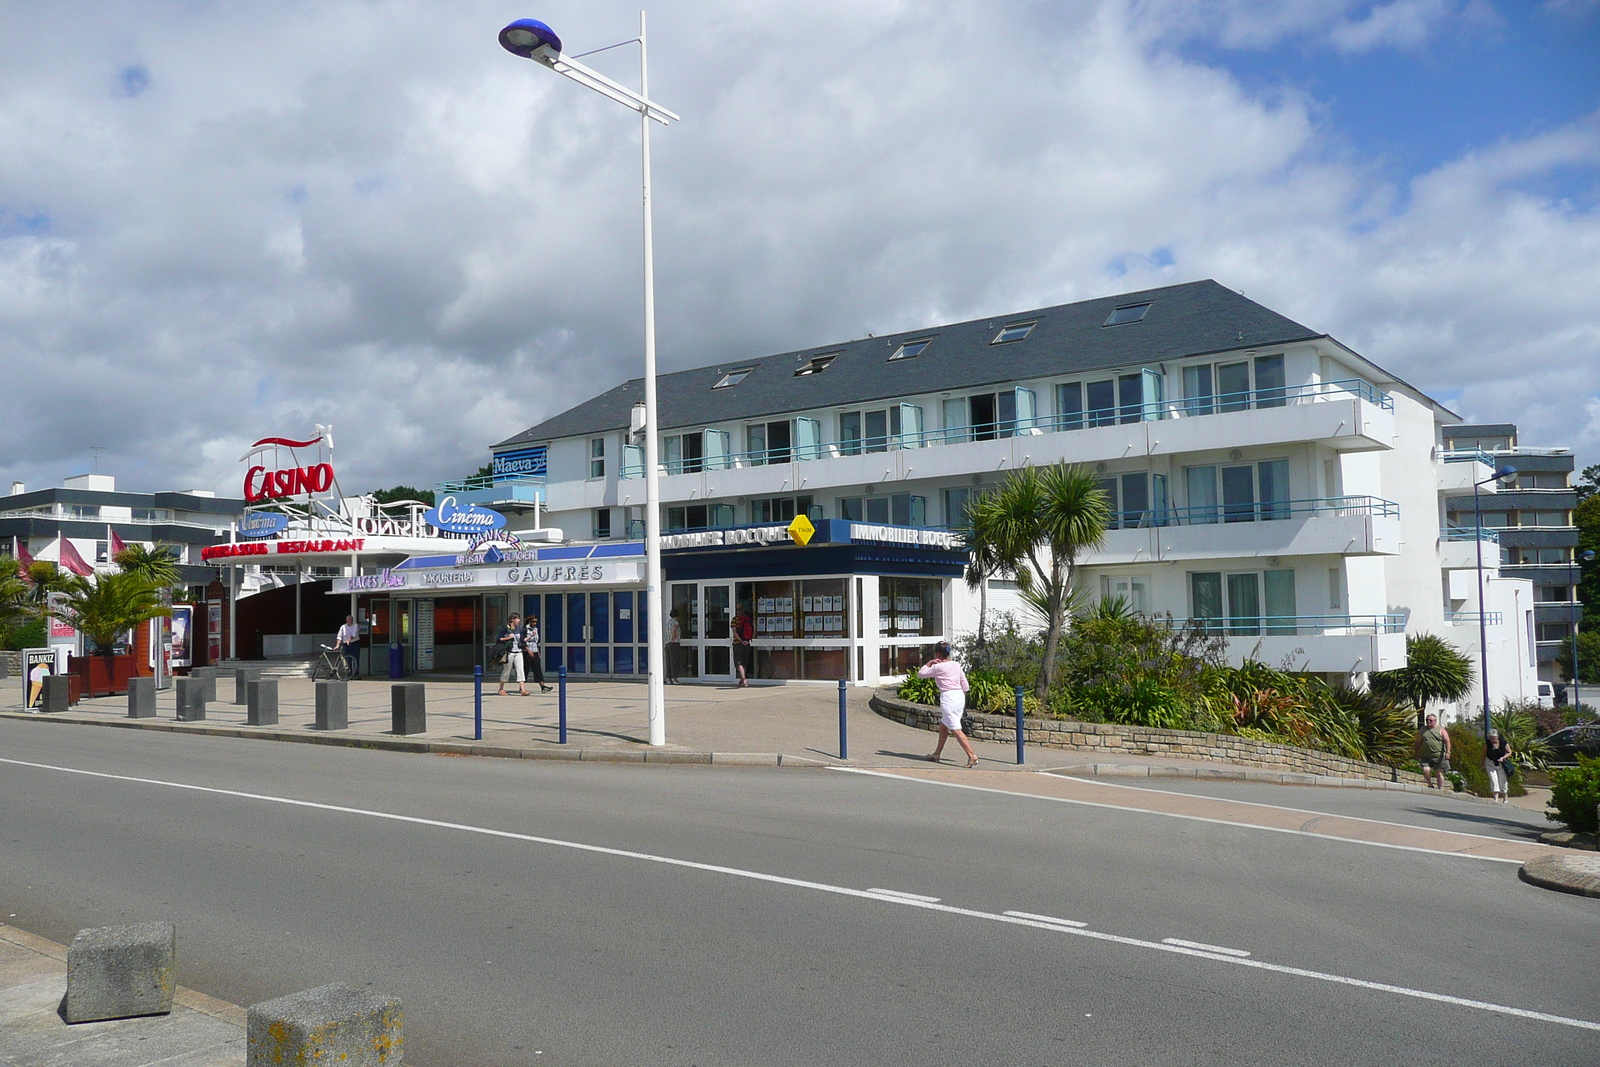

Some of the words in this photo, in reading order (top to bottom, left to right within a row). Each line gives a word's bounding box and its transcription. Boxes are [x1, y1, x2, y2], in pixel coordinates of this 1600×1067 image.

[494, 457, 532, 474] Maeva
[243, 463, 334, 502] CASINO
[437, 496, 495, 526] Cinéma
[467, 528, 521, 551] BANKIZ
[850, 523, 919, 544] IMMOBILIER
[277, 539, 366, 554] RESTAURANT
[455, 554, 485, 565] ARTISAN
[503, 550, 535, 561] GLACIER
[347, 576, 379, 589] GLACES
[507, 564, 604, 583] GAUFRES
[29, 654, 55, 665] BANKIZ
